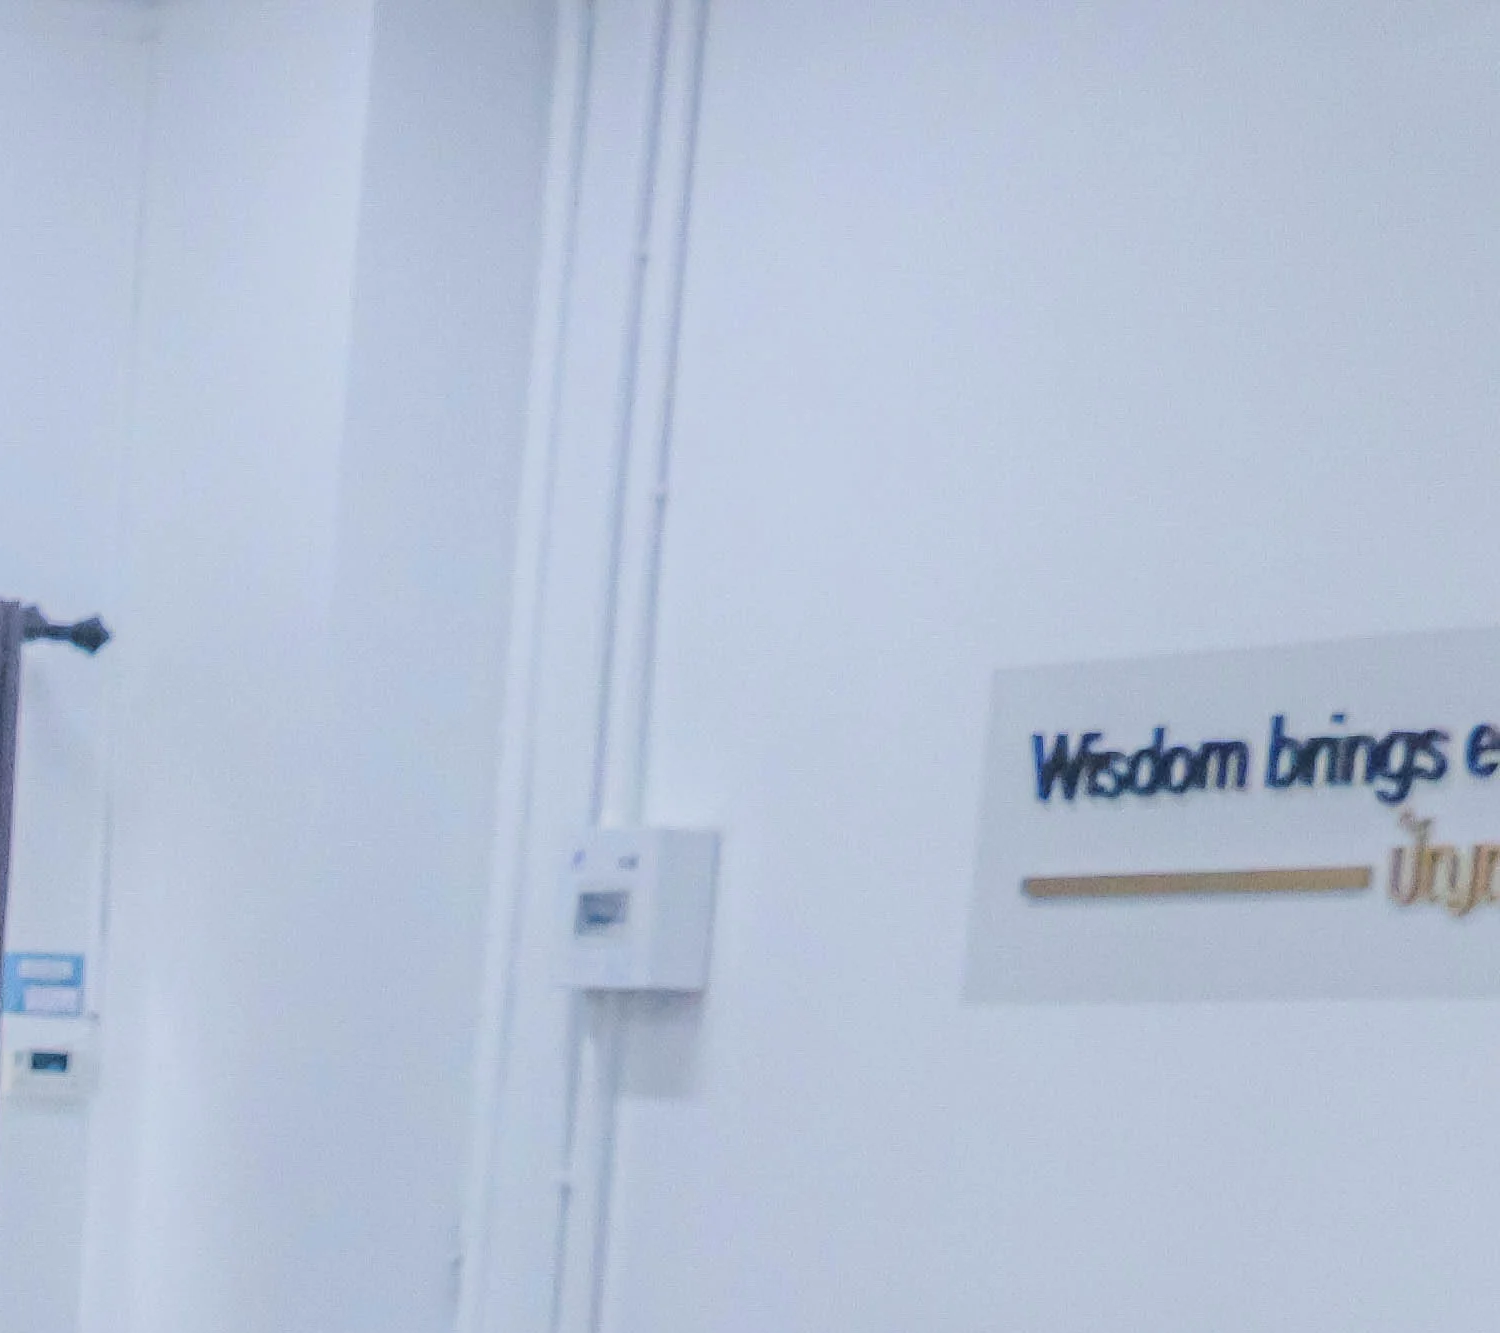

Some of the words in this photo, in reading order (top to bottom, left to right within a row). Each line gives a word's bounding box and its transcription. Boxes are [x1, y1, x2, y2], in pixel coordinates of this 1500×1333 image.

[1031, 727, 1249, 801] Wisdom
[1266, 713, 1449, 806] brings
[1388, 808, 1500, 918] ปัญ
